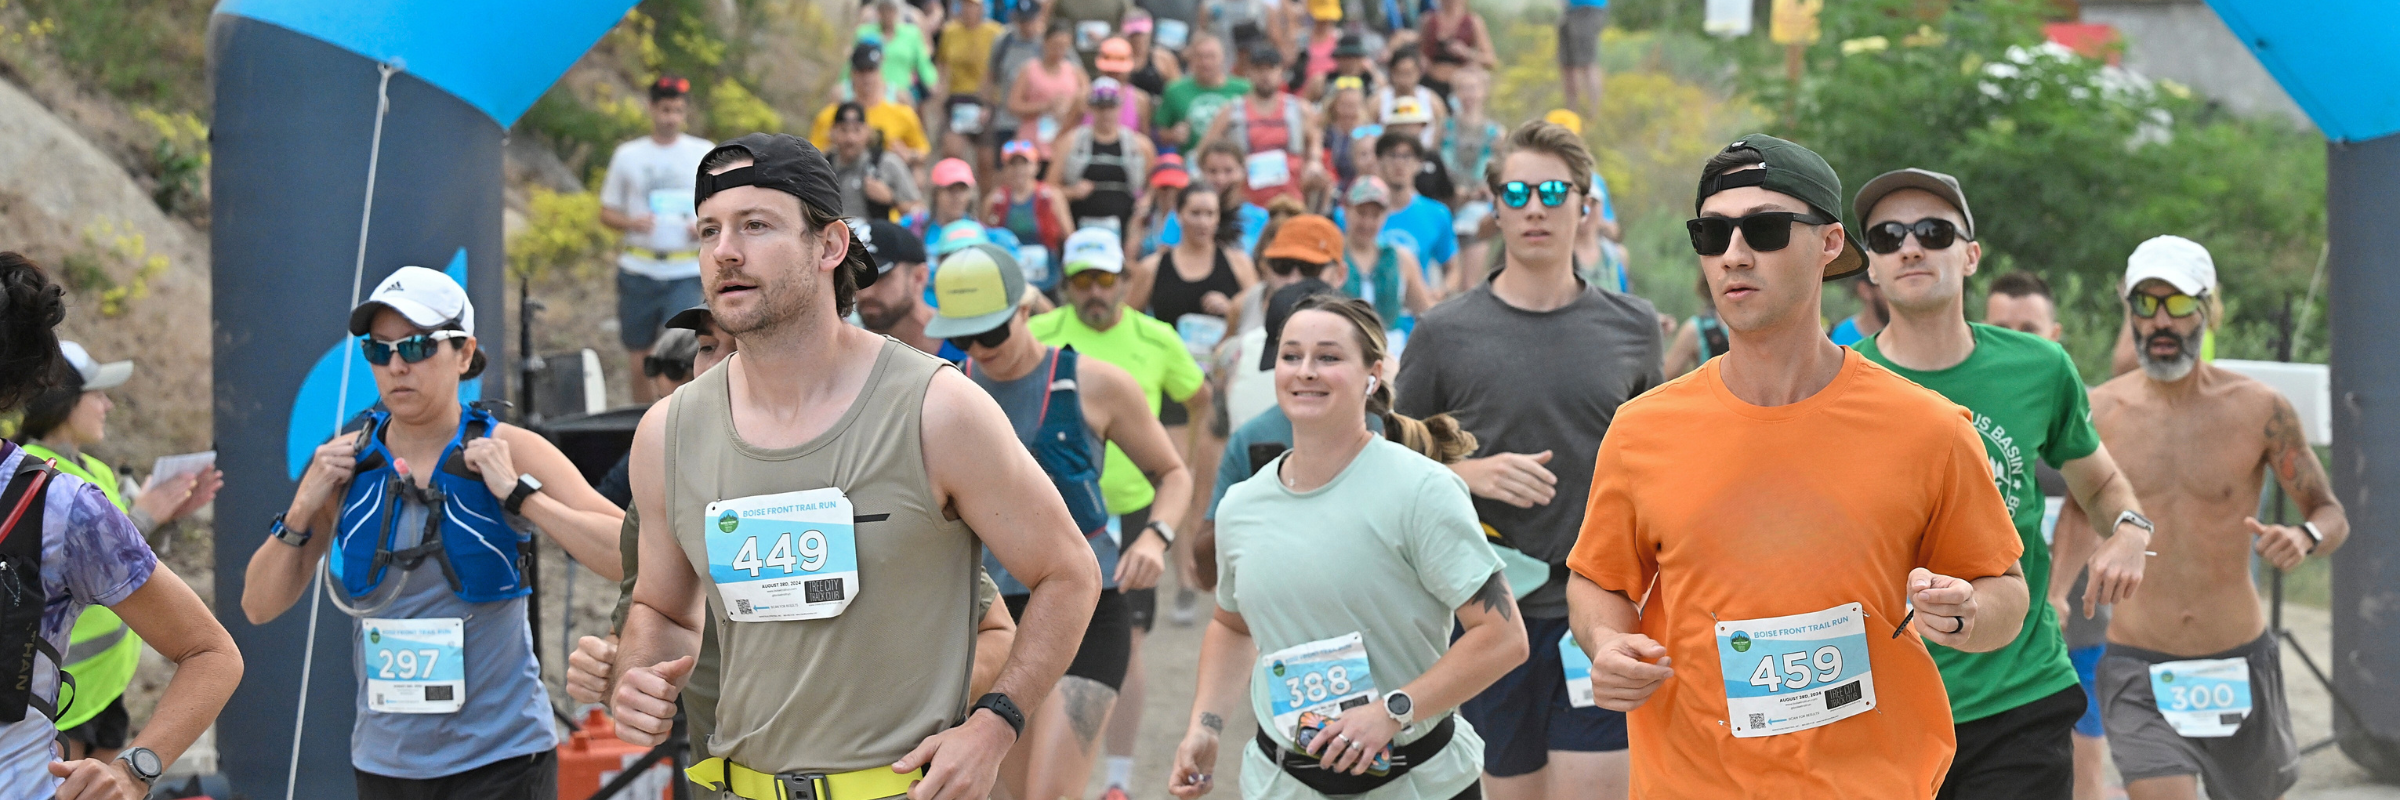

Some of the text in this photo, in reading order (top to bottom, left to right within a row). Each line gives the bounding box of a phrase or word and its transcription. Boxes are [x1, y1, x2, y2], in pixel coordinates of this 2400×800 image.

[1990, 425, 2023, 475] BASIN
[743, 501, 837, 518] BOISE FRONT TRAIL RUN
[731, 529, 828, 577] 449
[808, 581, 824, 592] TREE
[824, 579, 839, 592] CITY
[1753, 616, 1849, 639] BOISE FRONT TRAIL RUN
[379, 648, 440, 680] 297
[1750, 645, 1843, 692] 459
[1285, 665, 1352, 709] 388
[1779, 695, 1799, 703] AUGUST
[2170, 682, 2234, 710] 300
